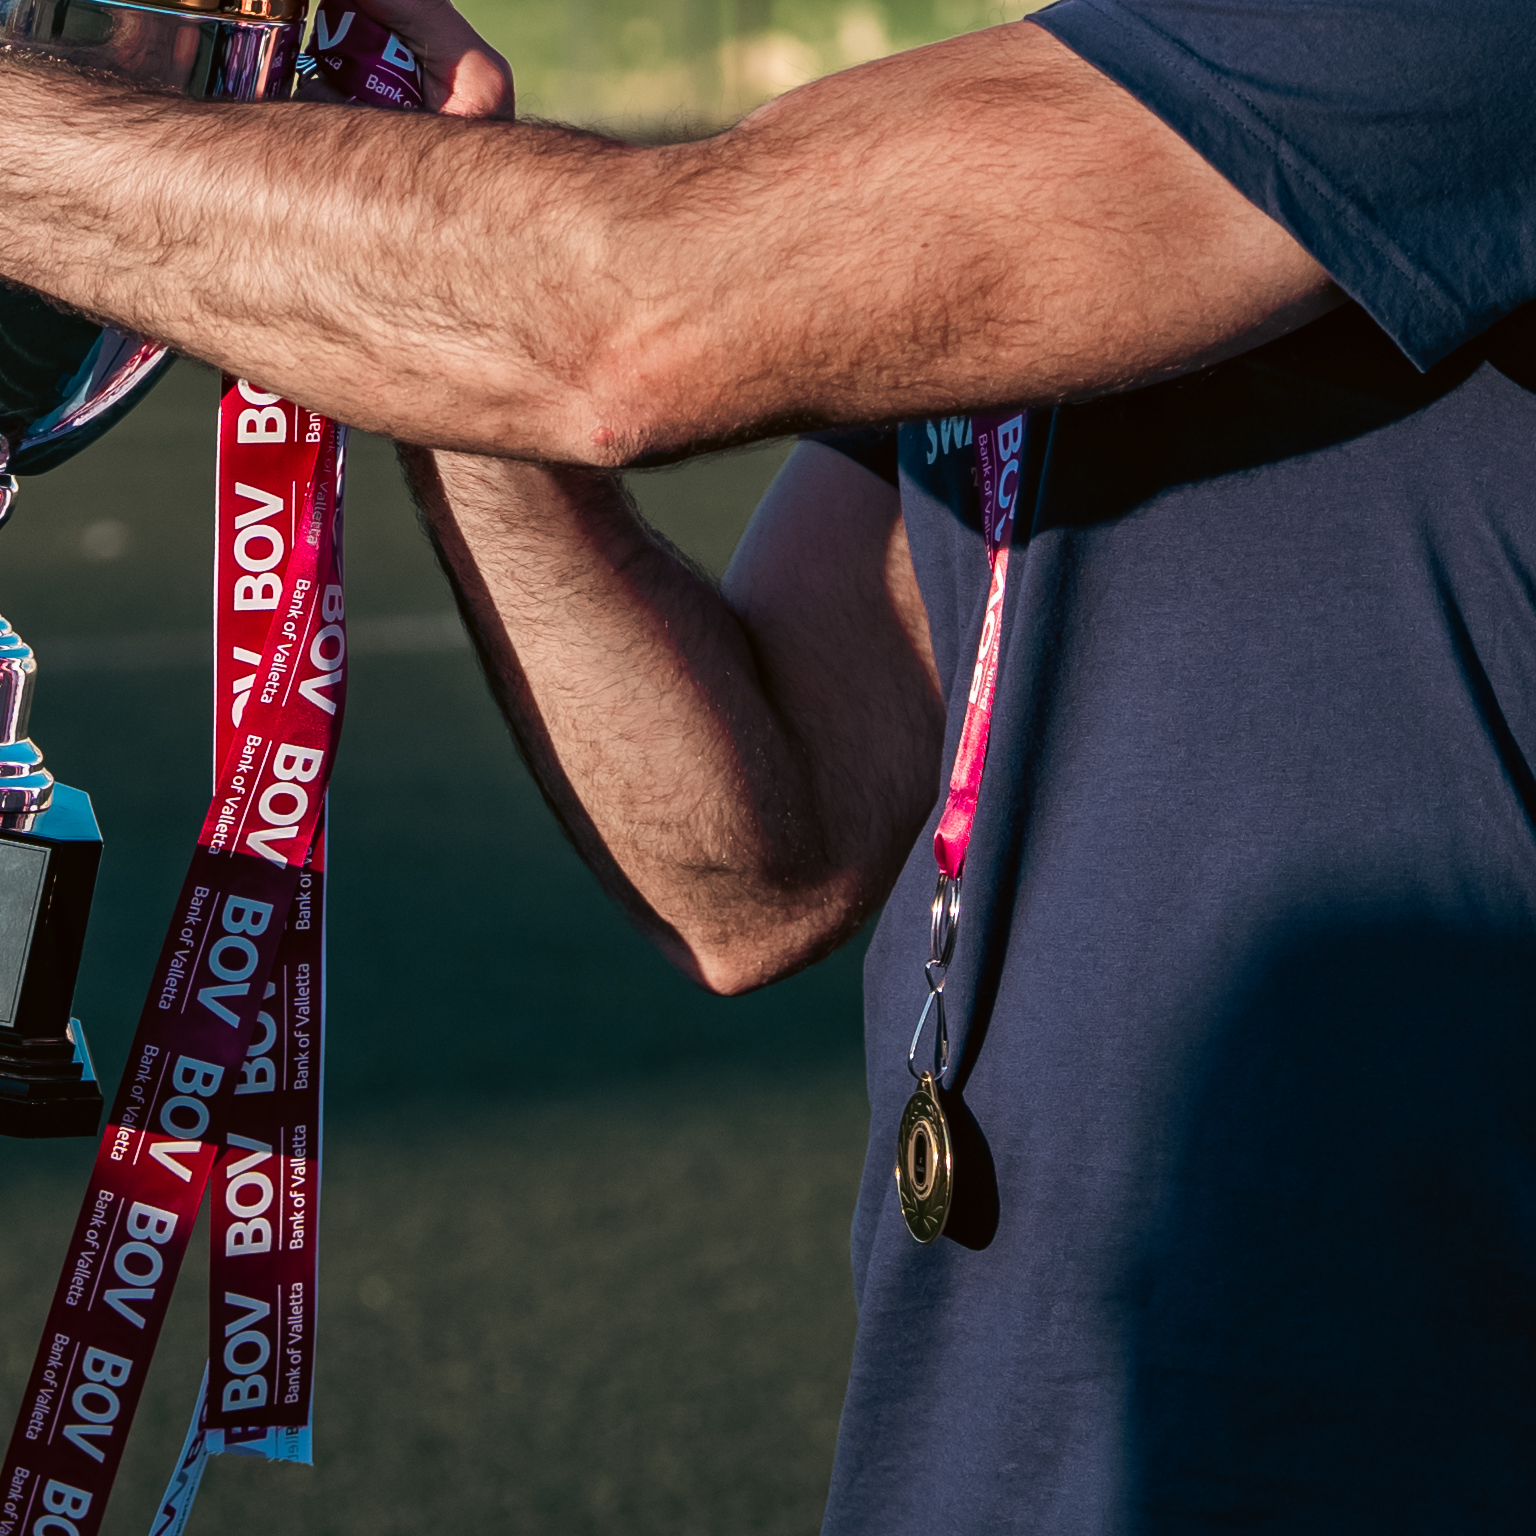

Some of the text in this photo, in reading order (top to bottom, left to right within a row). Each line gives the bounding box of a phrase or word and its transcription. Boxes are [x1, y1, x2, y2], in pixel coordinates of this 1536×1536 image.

[366, 74, 404, 103] Bank
[305, 408, 321, 444] Ban
[978, 433, 992, 478] Bank
[233, 481, 285, 612] BOV
[306, 480, 330, 547] Valletta
[983, 479, 993, 498] of
[260, 578, 311, 704] Bank of Valletta
[297, 584, 345, 716] BOV
[230, 774, 246, 796] of
[237, 733, 262, 774] Bank
[245, 742, 325, 870] BOV
[208, 796, 241, 855] Valletta
[158, 885, 210, 1011] Bank of Valletta
[197, 894, 274, 1028] BOV
[295, 891, 311, 930] Bank
[293, 962, 310, 1090] Bank of Valletta
[110, 1044, 160, 1162] Bank of Valletta
[148, 1054, 225, 1182] BOV
[225, 1132, 274, 1257] BOV
[289, 1124, 307, 1250] Bank of Valletta
[65, 1189, 115, 1307] Bank of Valletta
[102, 1201, 179, 1329] BOV
[221, 1291, 271, 1412] BOV
[286, 1345, 303, 1365] of
[287, 1282, 303, 1346] Valletta
[25, 1333, 70, 1441] Bank of Valletta
[62, 1346, 134, 1464] BOV
[284, 1366, 302, 1405] Bank
[4, 1466, 31, 1521] Bank of
